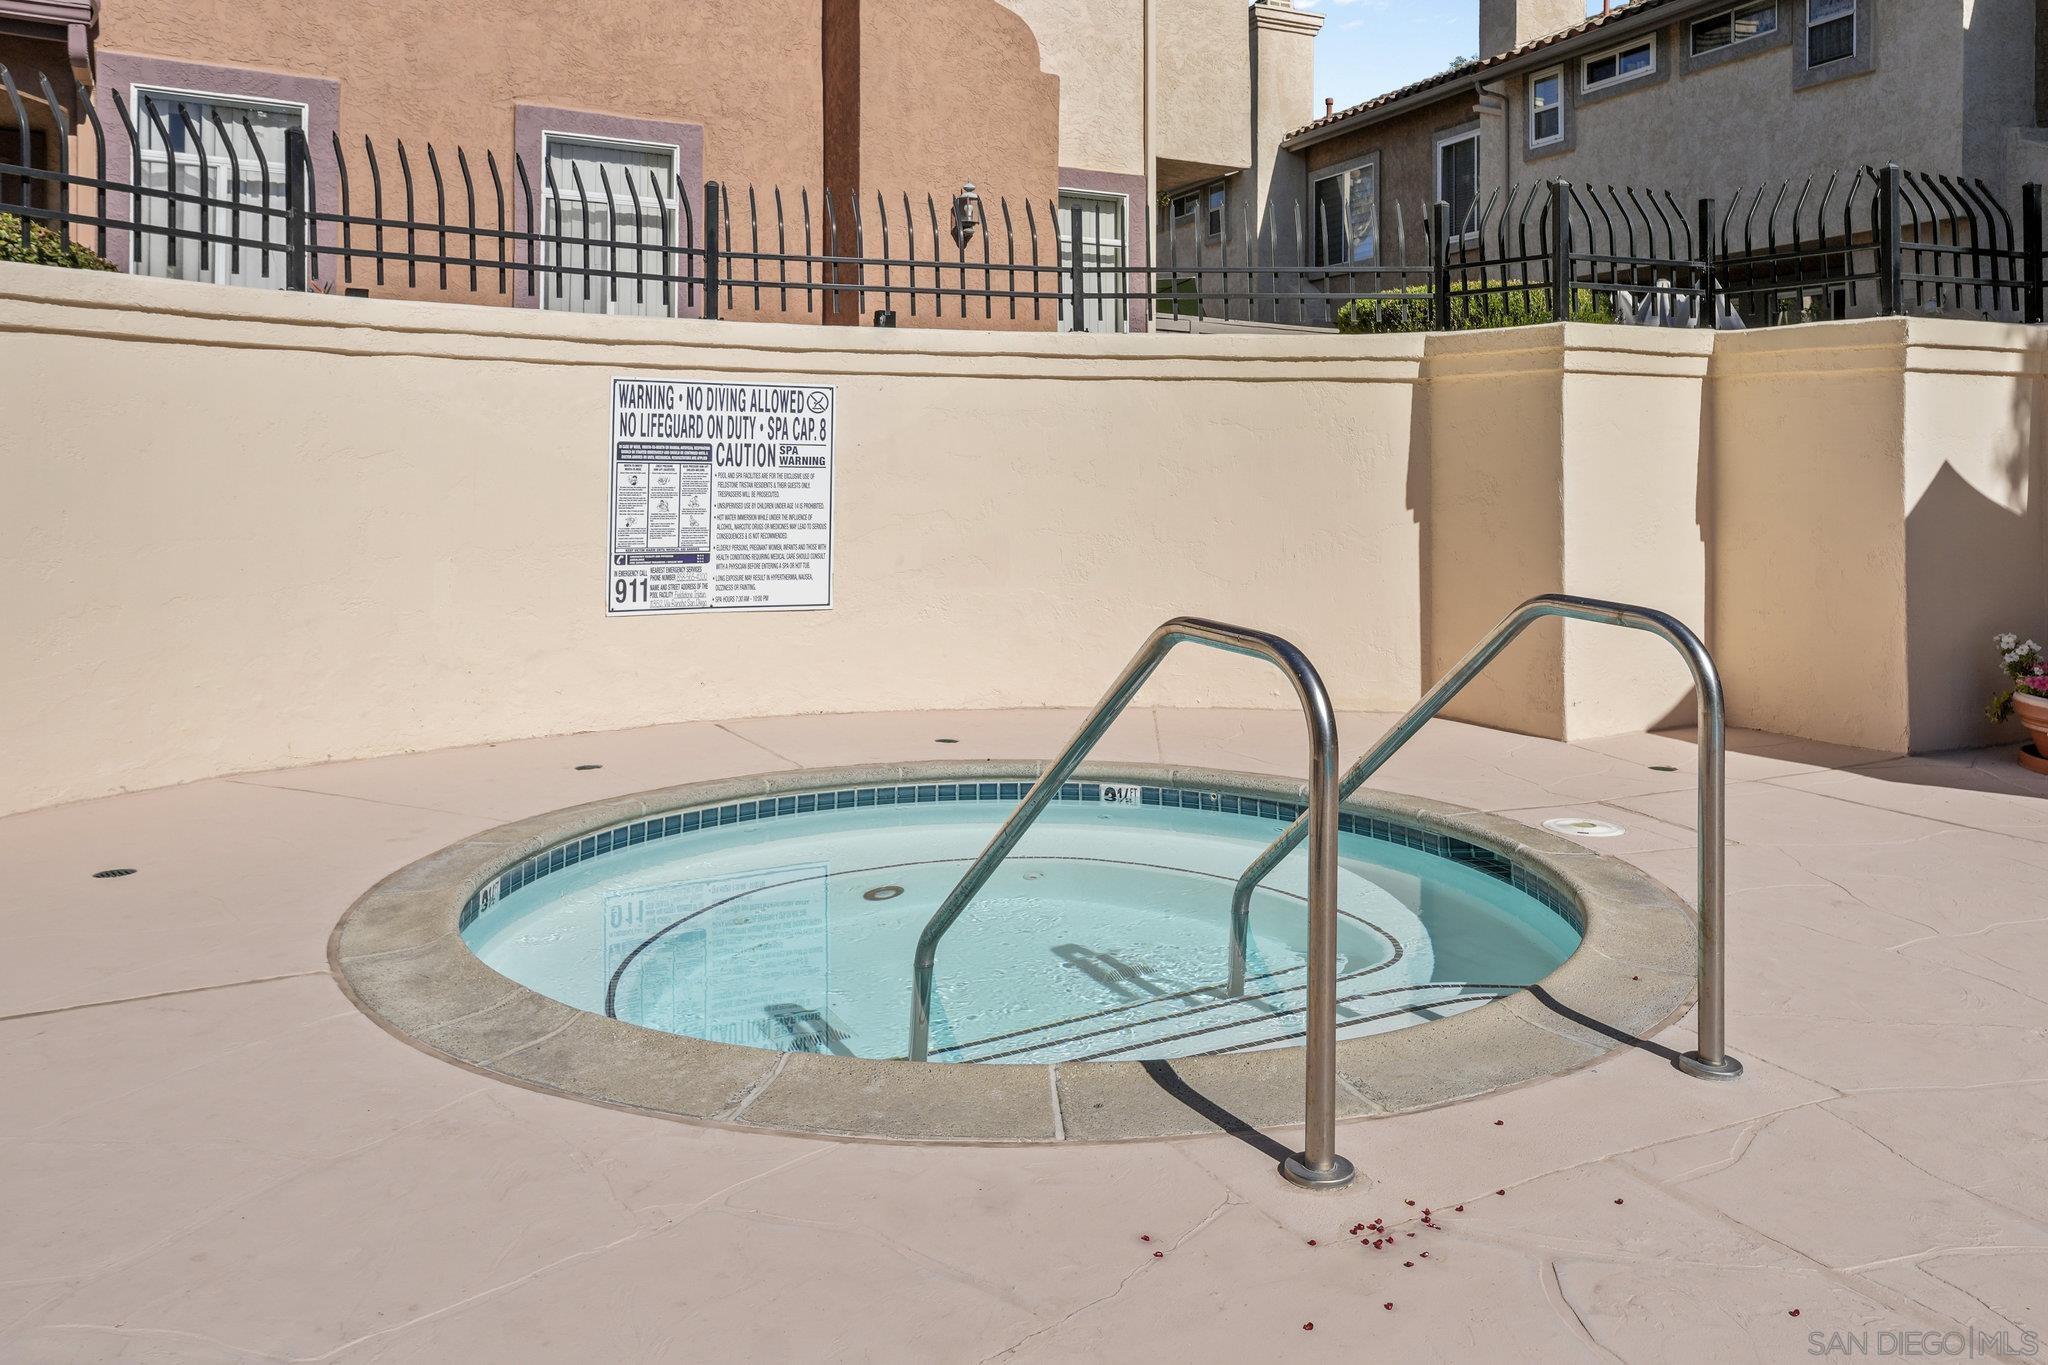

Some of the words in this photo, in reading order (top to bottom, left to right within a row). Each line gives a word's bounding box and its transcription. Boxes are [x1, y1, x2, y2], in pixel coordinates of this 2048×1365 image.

[619, 384, 674, 409] WARNING
[687, 386, 702, 411] NO
[706, 388, 745, 412] DIVING
[750, 389, 804, 413] ALLOWED
[620, 412, 636, 437] NO
[641, 413, 703, 438] LIFEGUARD
[708, 415, 722, 439] ON
[728, 416, 755, 440] DUTY
[768, 417, 788, 440] SPA
[793, 418, 817, 441] CAP.
[820, 418, 826, 441] 8
[716, 443, 775, 467] CAUTION
[780, 446, 798, 454] SPA
[780, 457, 825, 465] WARNING
[616, 578, 647, 603] 911
